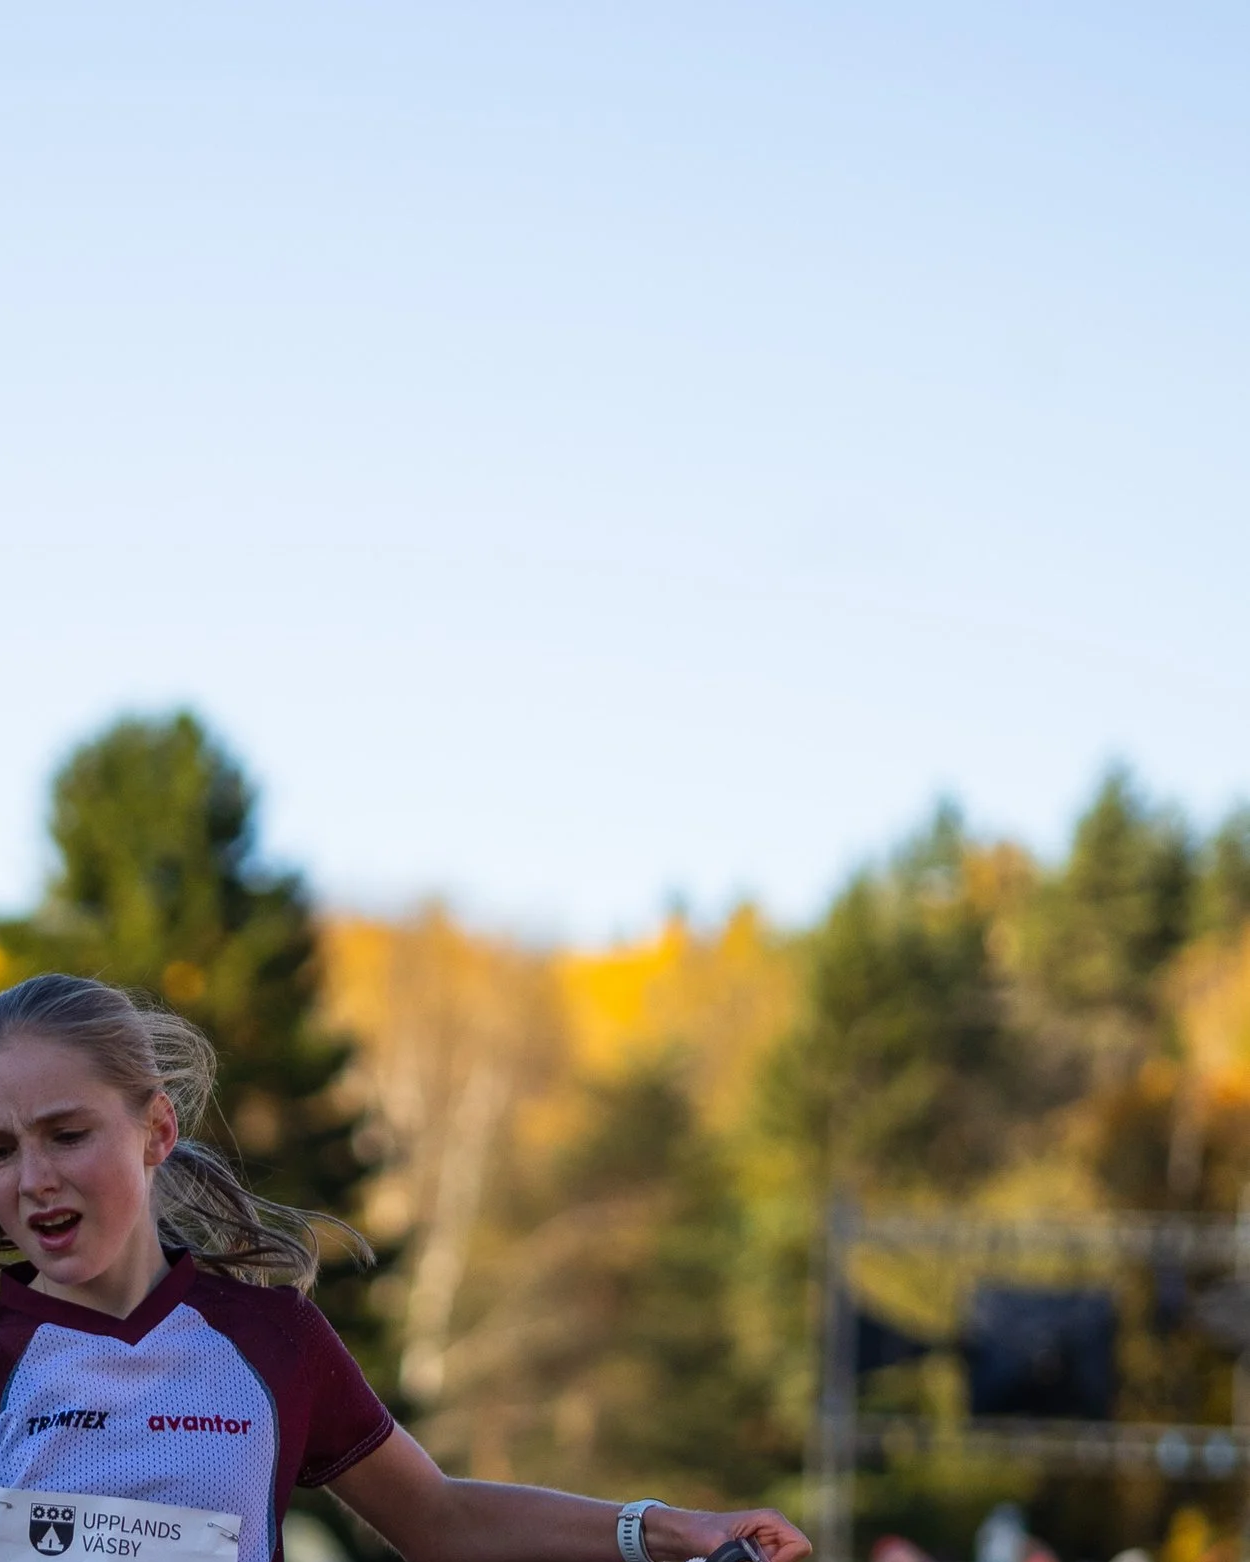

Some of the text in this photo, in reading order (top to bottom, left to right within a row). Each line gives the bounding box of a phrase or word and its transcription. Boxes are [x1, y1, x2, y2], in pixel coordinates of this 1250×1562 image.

[26, 1409, 109, 1436] TRIMTEX
[148, 1414, 252, 1435] avantor
[83, 1512, 182, 1541] UPPLANDS
[82, 1533, 142, 1558] VÄSBY
